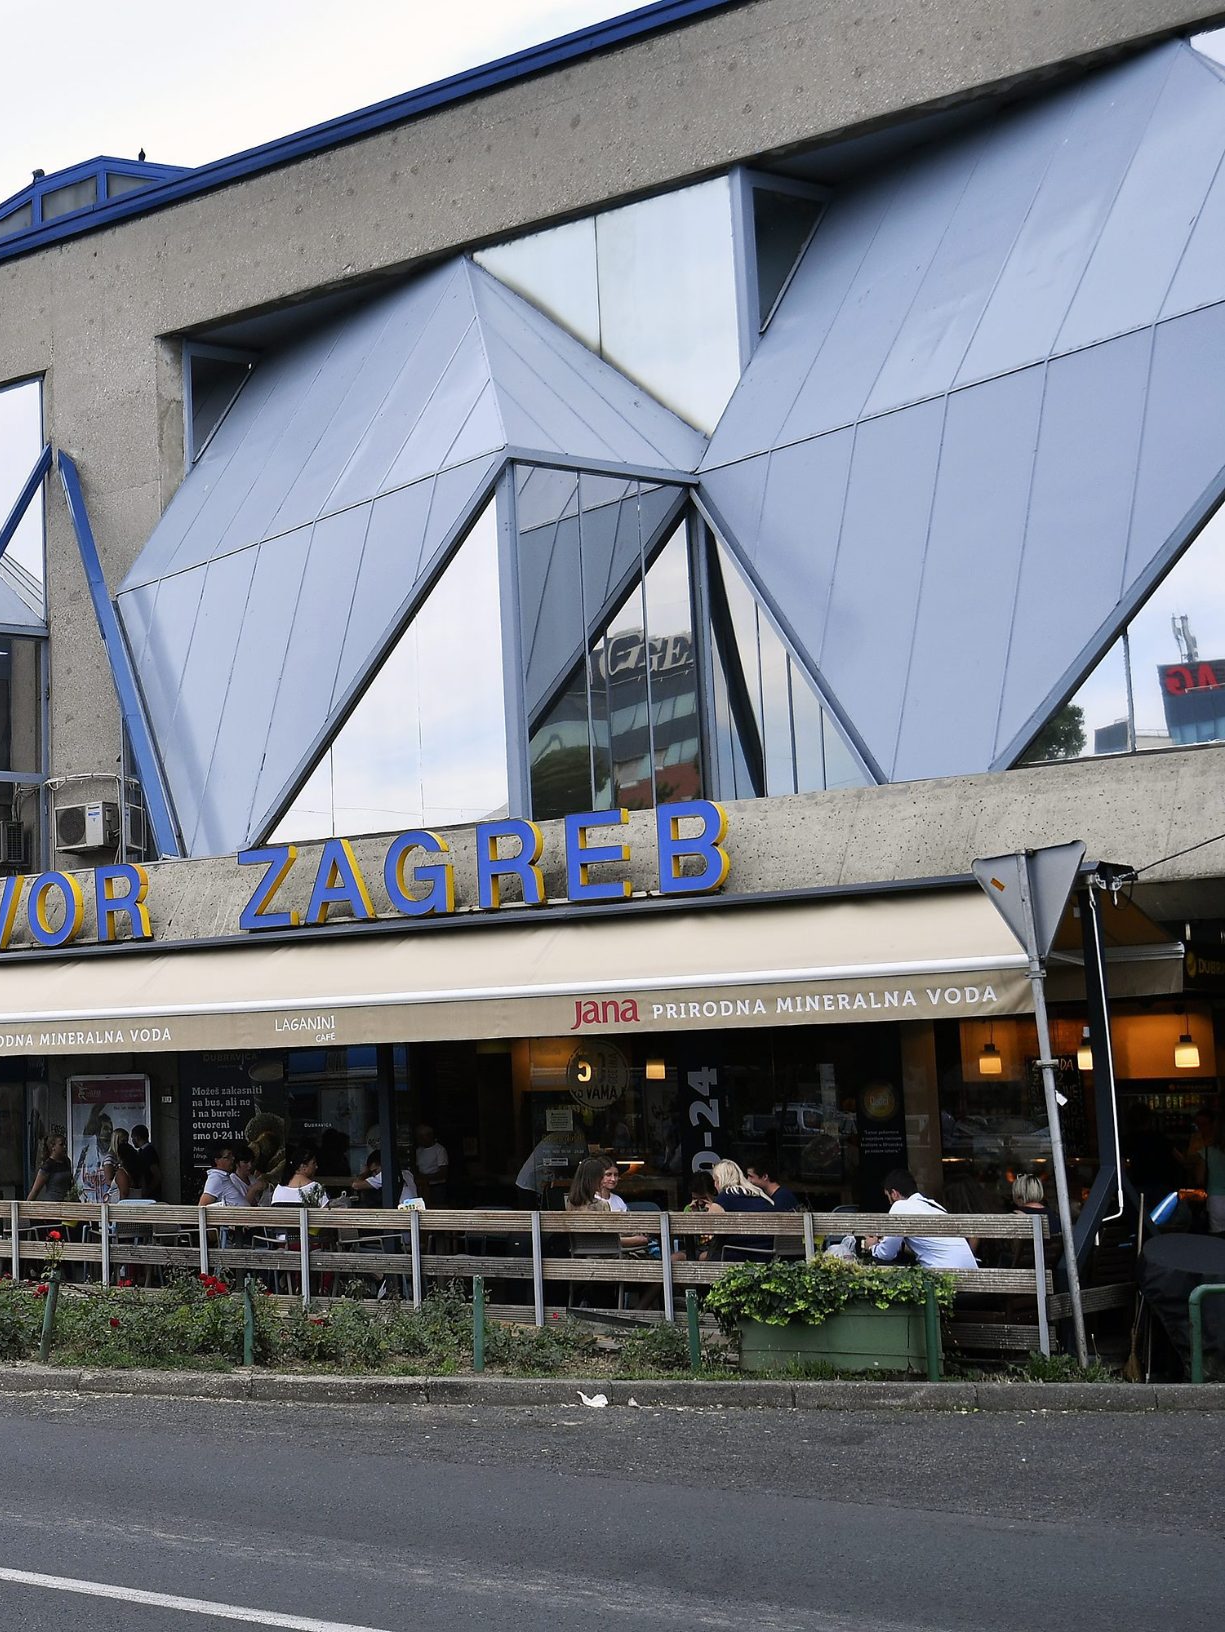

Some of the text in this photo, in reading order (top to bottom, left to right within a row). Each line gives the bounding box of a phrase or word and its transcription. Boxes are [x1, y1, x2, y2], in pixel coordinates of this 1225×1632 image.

[237, 800, 731, 931] ZAGREB
[652, 998, 766, 1019] PRIRODNA
[776, 990, 917, 1013] MINERALNA
[926, 985, 998, 1005] VODA
[275, 1015, 336, 1031] LAGANINI
[39, 1030, 124, 1046] MINERALNA
[130, 1027, 172, 1042] VODA
[191, 1085, 263, 1096] Možeš zakasniti
[205, 1098, 223, 1107] bus,
[225, 1097, 237, 1106] ali
[198, 1110, 210, 1118] na
[211, 1109, 240, 1118] burek:
[192, 1120, 230, 1129] otvoreni
[212, 1131, 233, 1140] 0-24
[235, 1131, 244, 1140] h!
